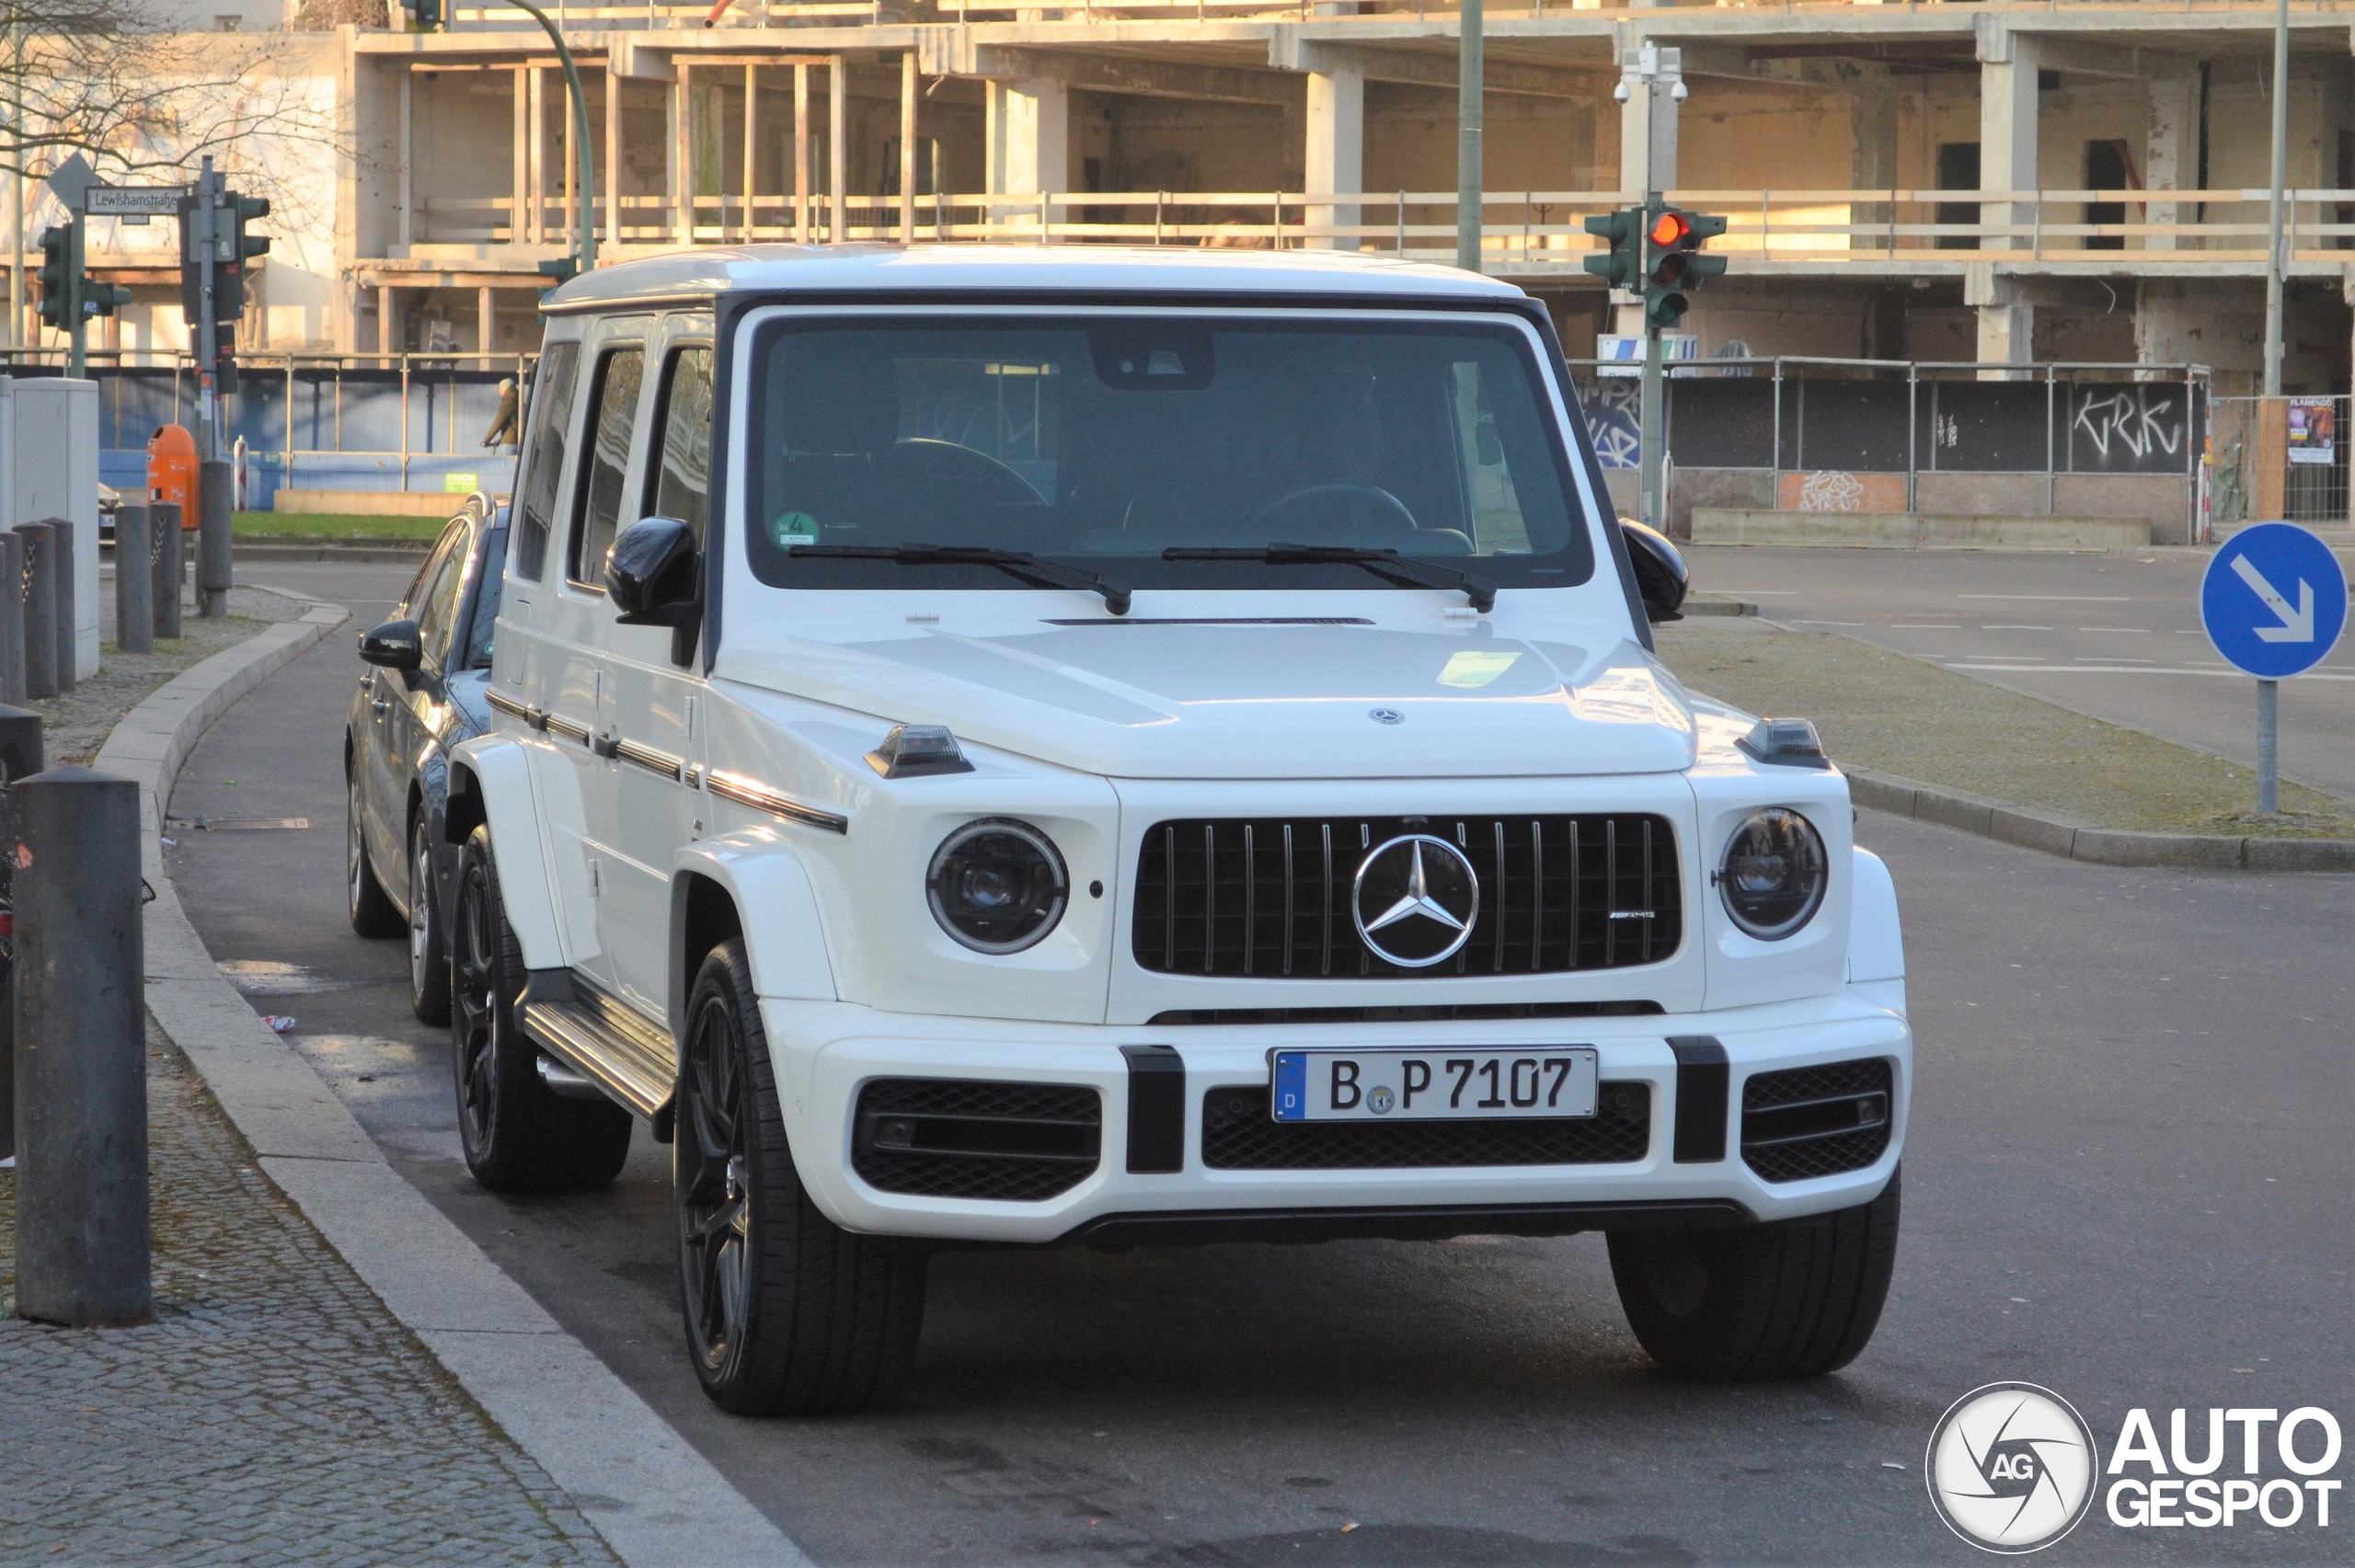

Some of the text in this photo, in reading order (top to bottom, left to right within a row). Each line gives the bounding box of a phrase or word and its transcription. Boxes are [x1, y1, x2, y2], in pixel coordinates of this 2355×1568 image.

[95, 192, 178, 208] Lewishamstraße
[790, 515, 804, 533] 4
[1330, 1058, 1572, 1109] B P 7107
[1284, 1093, 1295, 1108] D
